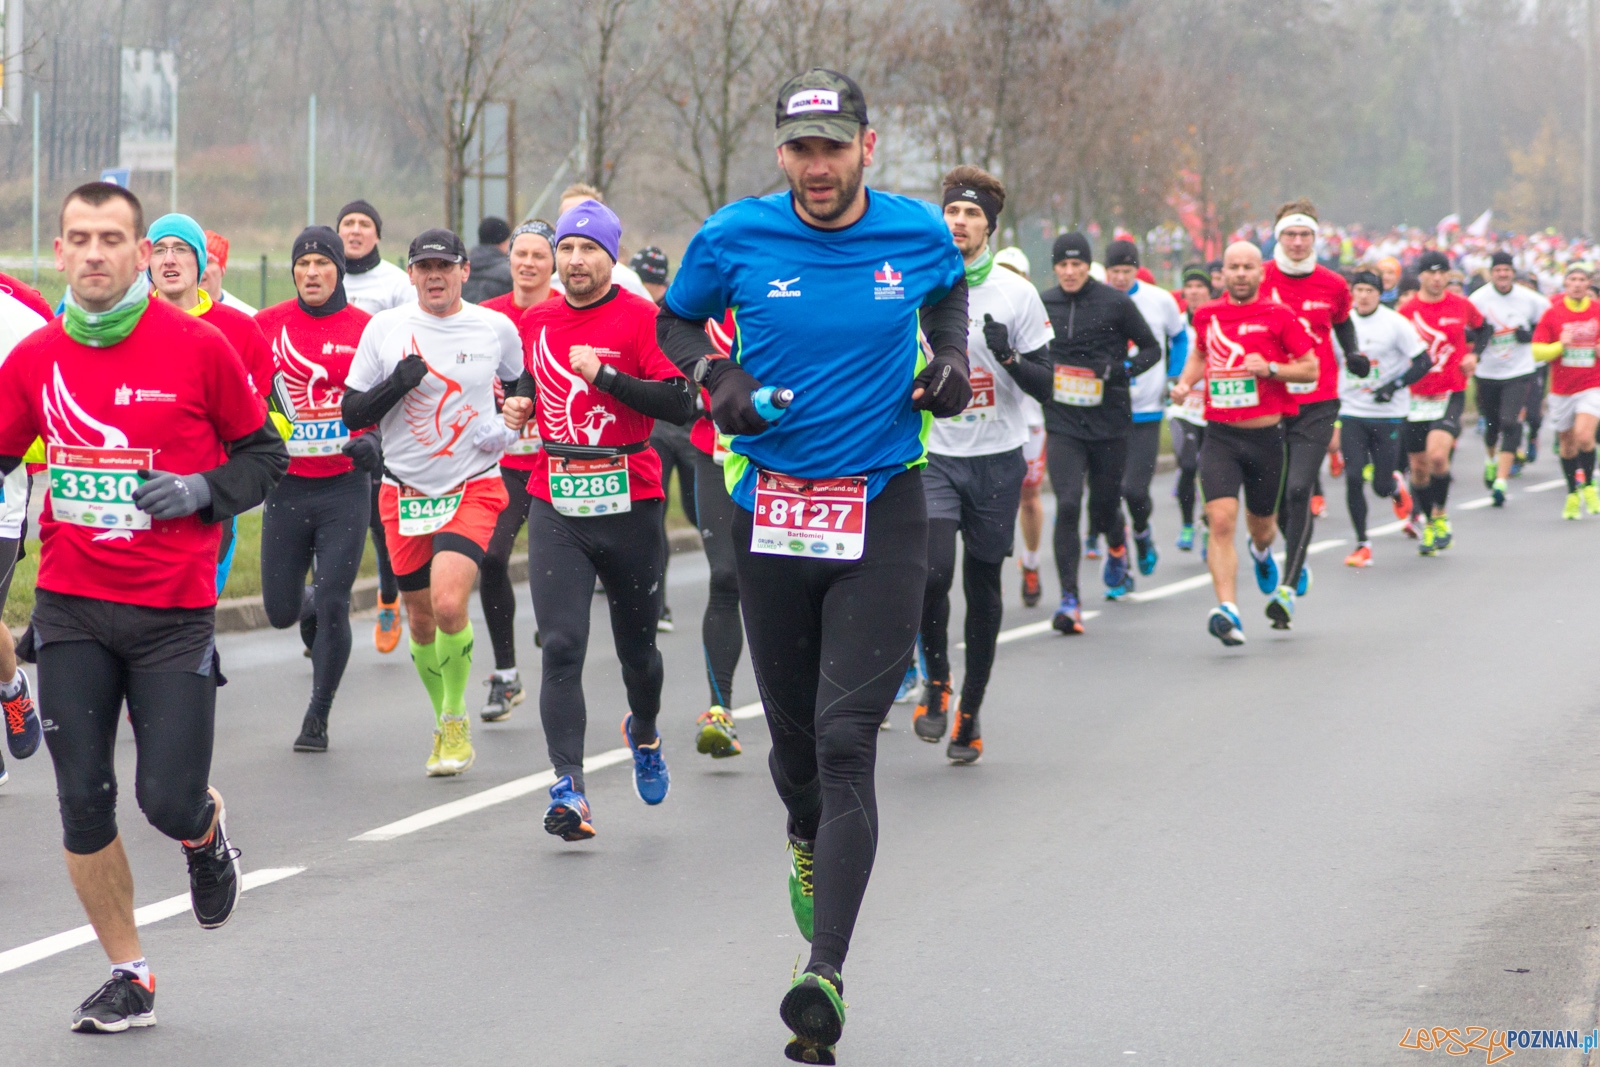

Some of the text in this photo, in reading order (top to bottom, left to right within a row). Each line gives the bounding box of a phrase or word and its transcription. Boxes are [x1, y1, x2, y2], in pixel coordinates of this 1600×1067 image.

[1217, 381, 1245, 394] 912
[293, 421, 340, 440] 3071
[61, 472, 138, 501] 3330
[560, 475, 620, 497] 9286
[408, 497, 457, 518] 9442
[758, 499, 852, 530] B 8127
